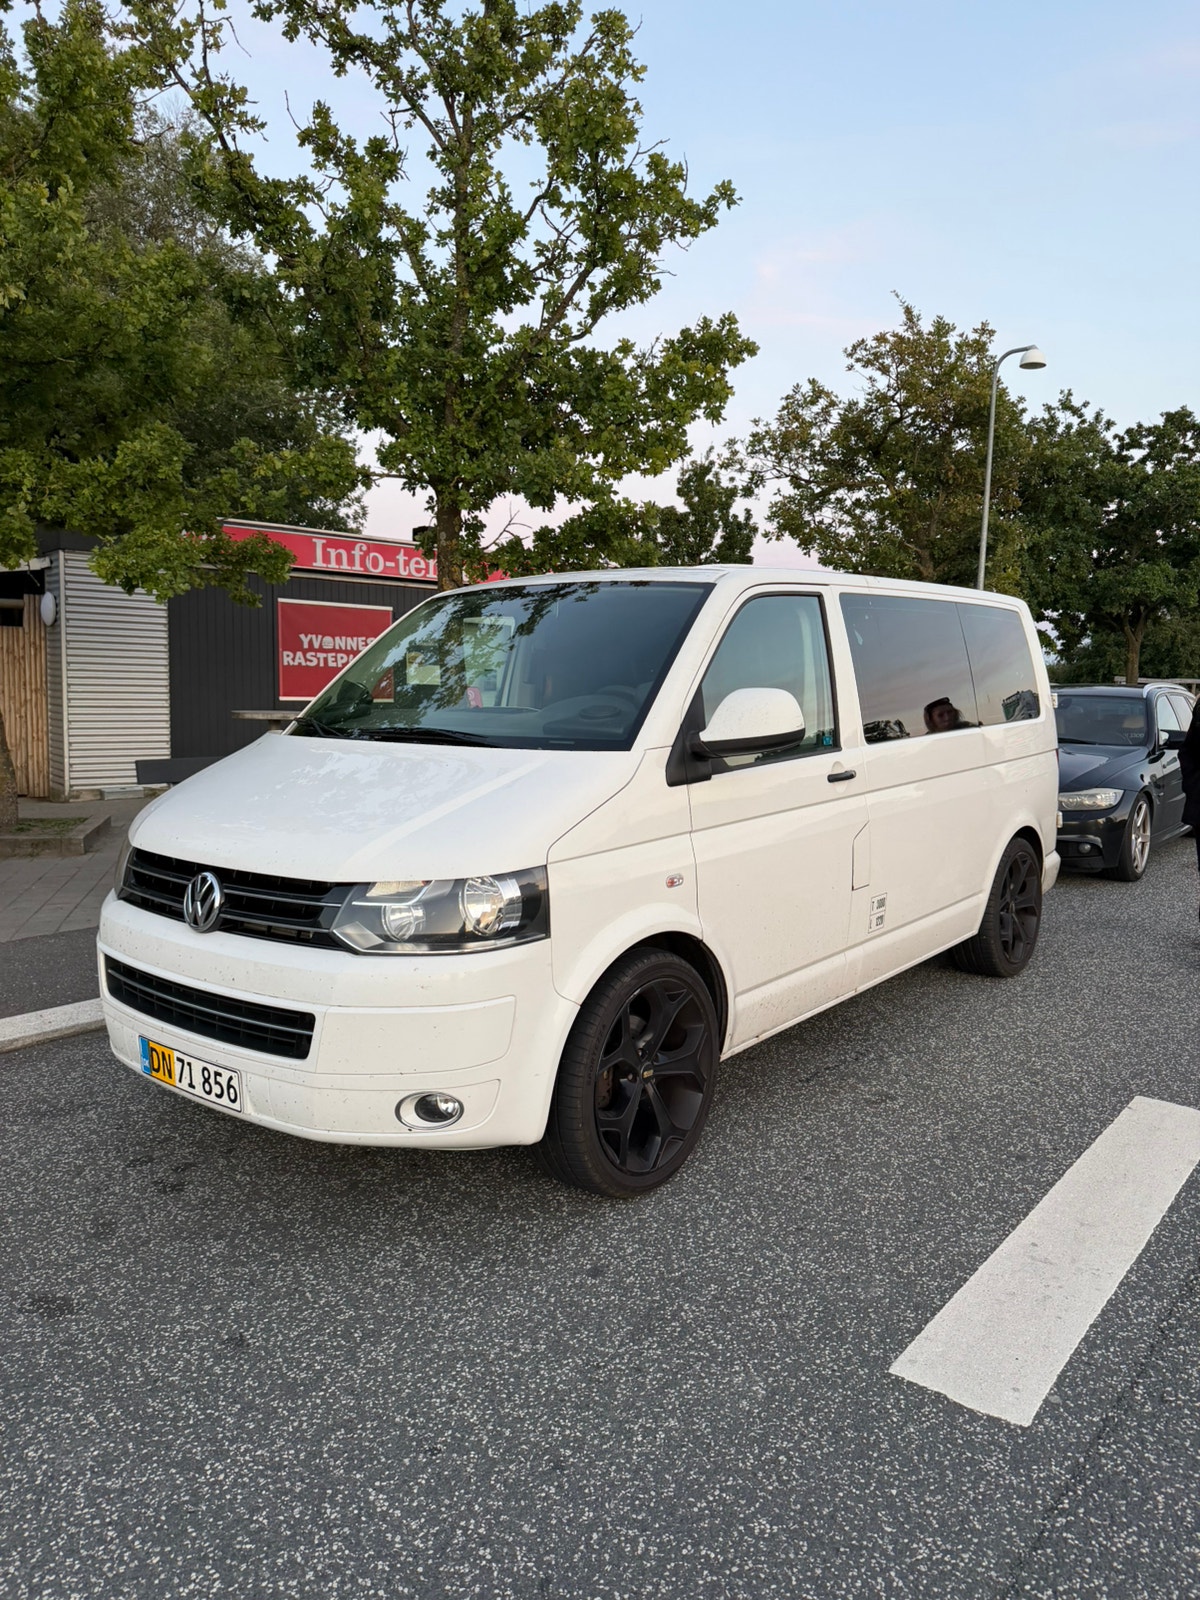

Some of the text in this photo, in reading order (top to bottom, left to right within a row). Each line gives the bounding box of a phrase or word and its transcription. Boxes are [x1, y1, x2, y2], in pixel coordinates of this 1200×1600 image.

[312, 538, 437, 578] Info-ter
[282, 651, 354, 668] RASTEP
[150, 1046, 237, 1104] DN 71 856
